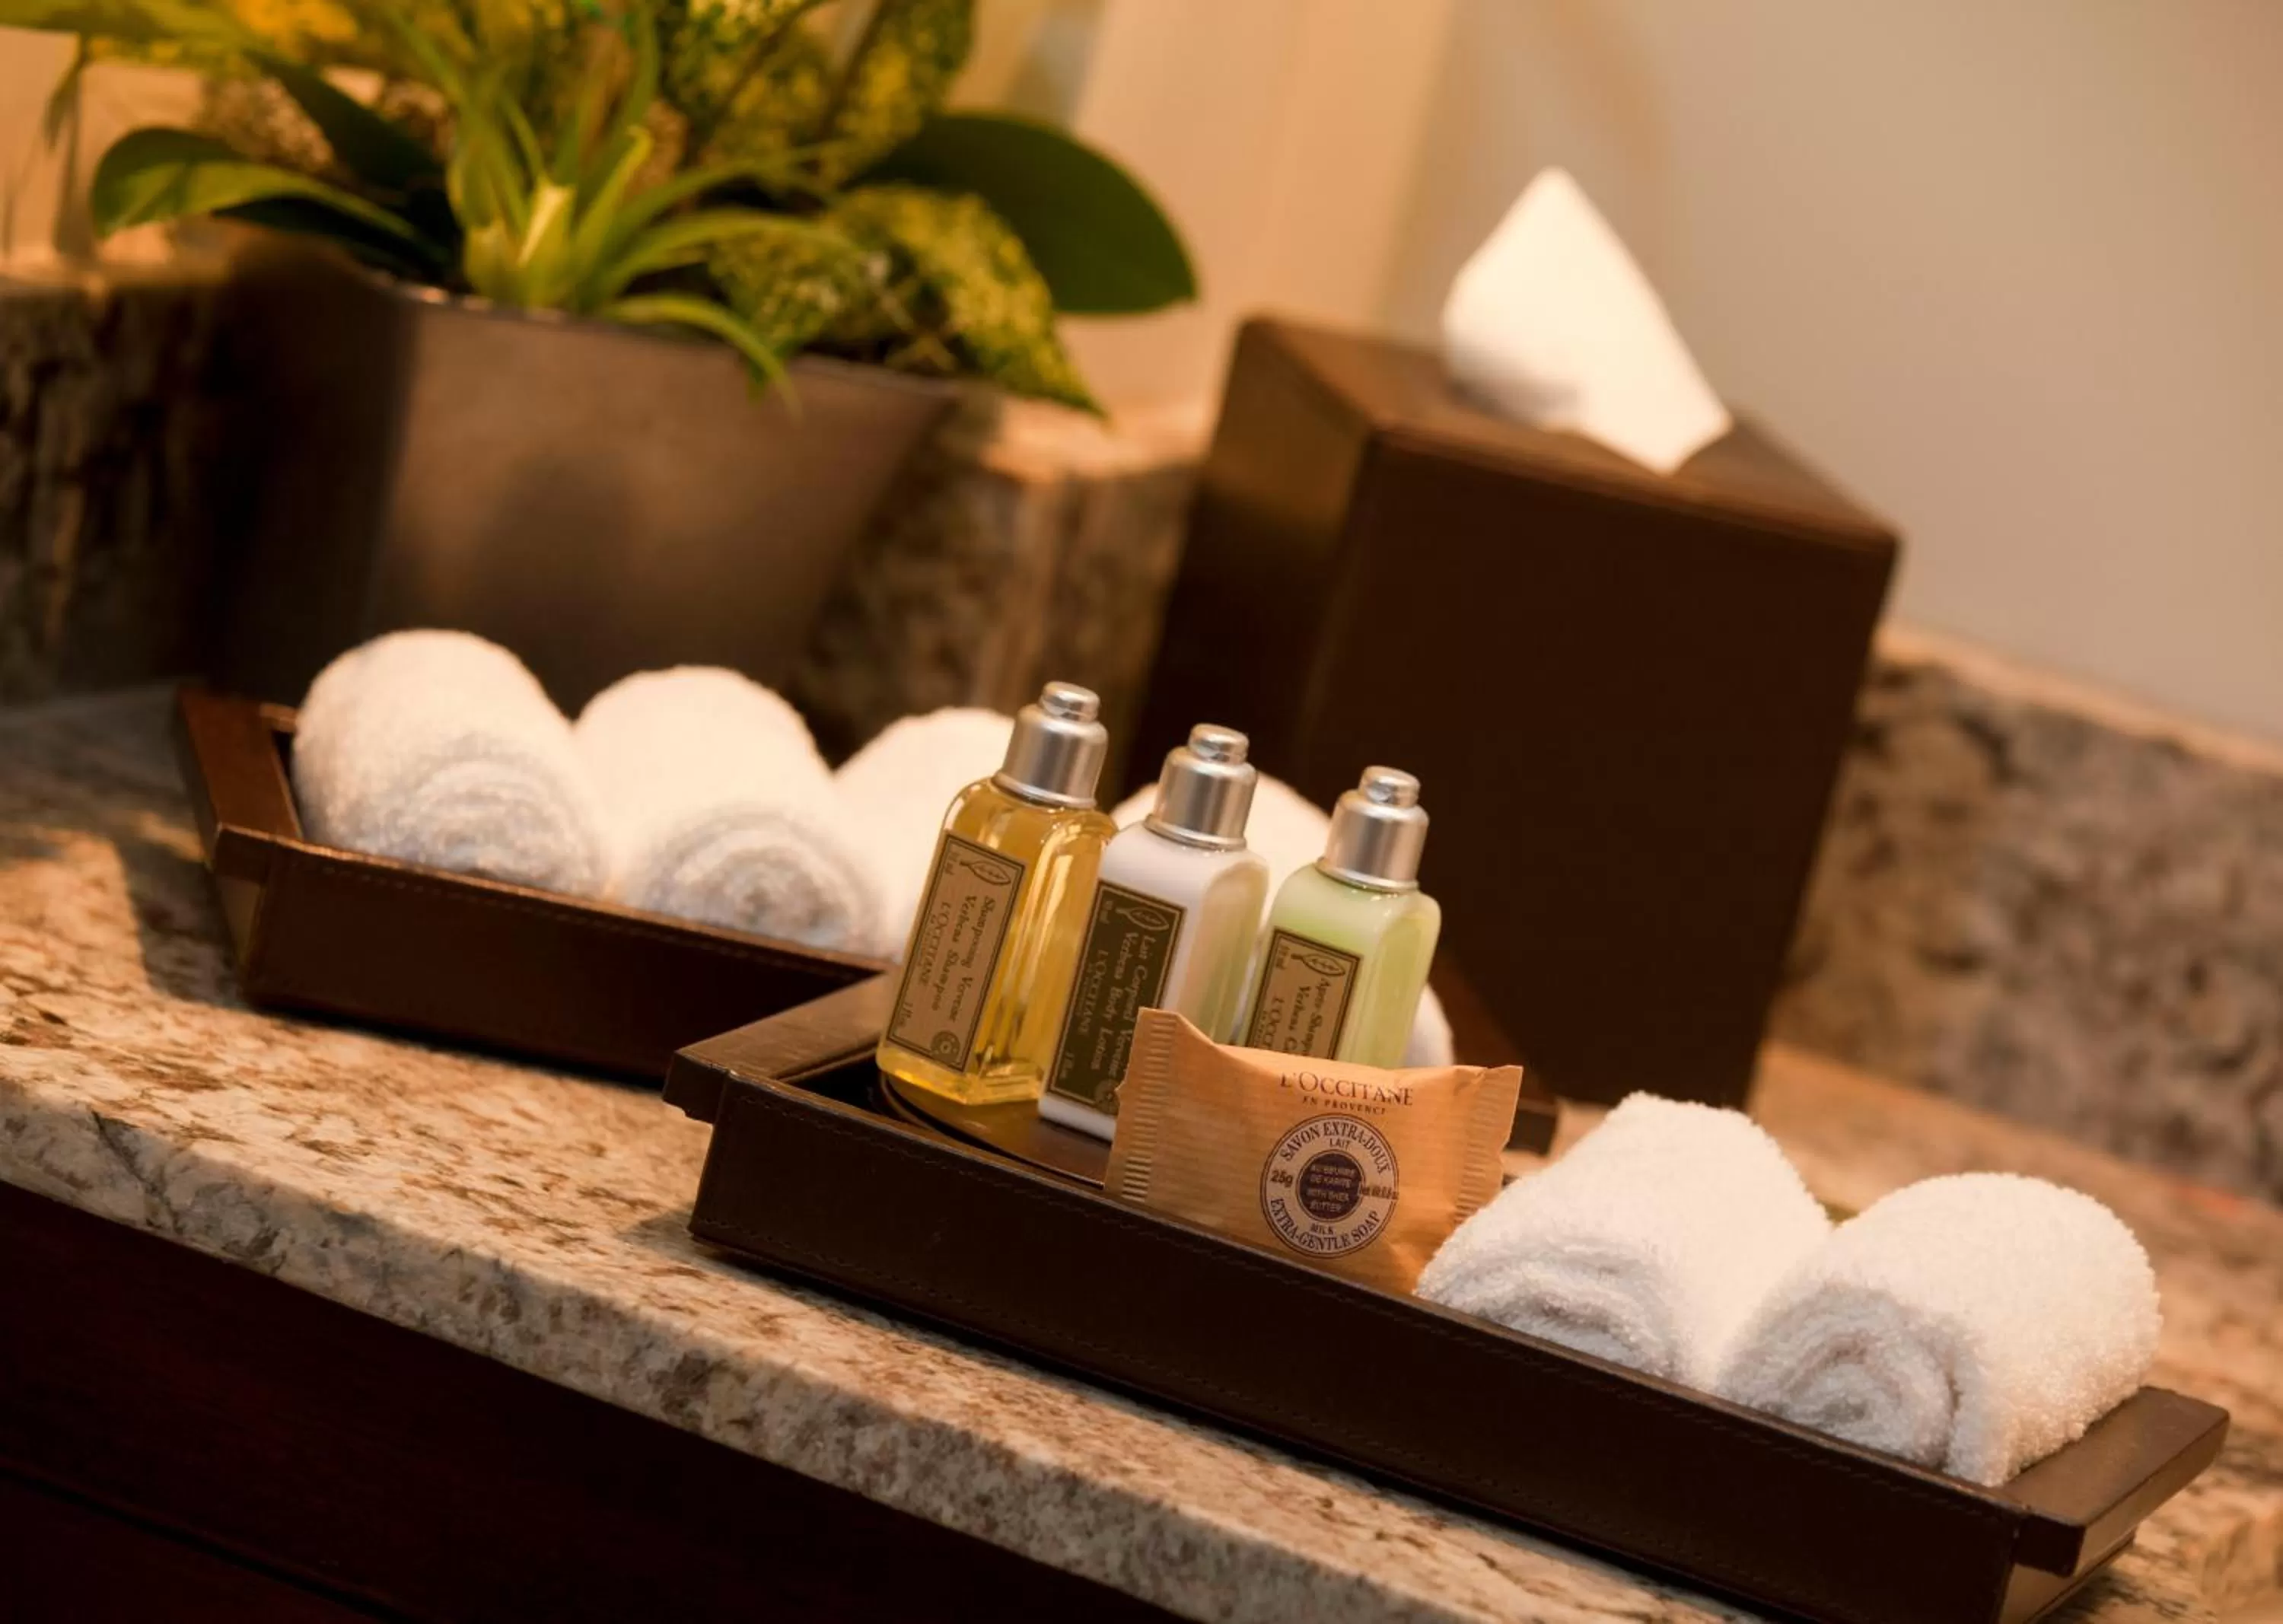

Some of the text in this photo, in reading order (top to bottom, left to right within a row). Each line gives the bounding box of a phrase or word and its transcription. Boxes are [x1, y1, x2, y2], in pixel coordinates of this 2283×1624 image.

[1280, 1072, 1413, 1106] L'OCCITANE
[1325, 1100, 1386, 1115] PROVENCE
[1280, 1121, 1390, 1174] SAVON EXTRA-DOUX
[1329, 1138, 1350, 1149] LAIT
[1270, 1170, 1293, 1188] 25g
[1271, 1198, 1380, 1250] EXTRA-GENTLE SOAP
